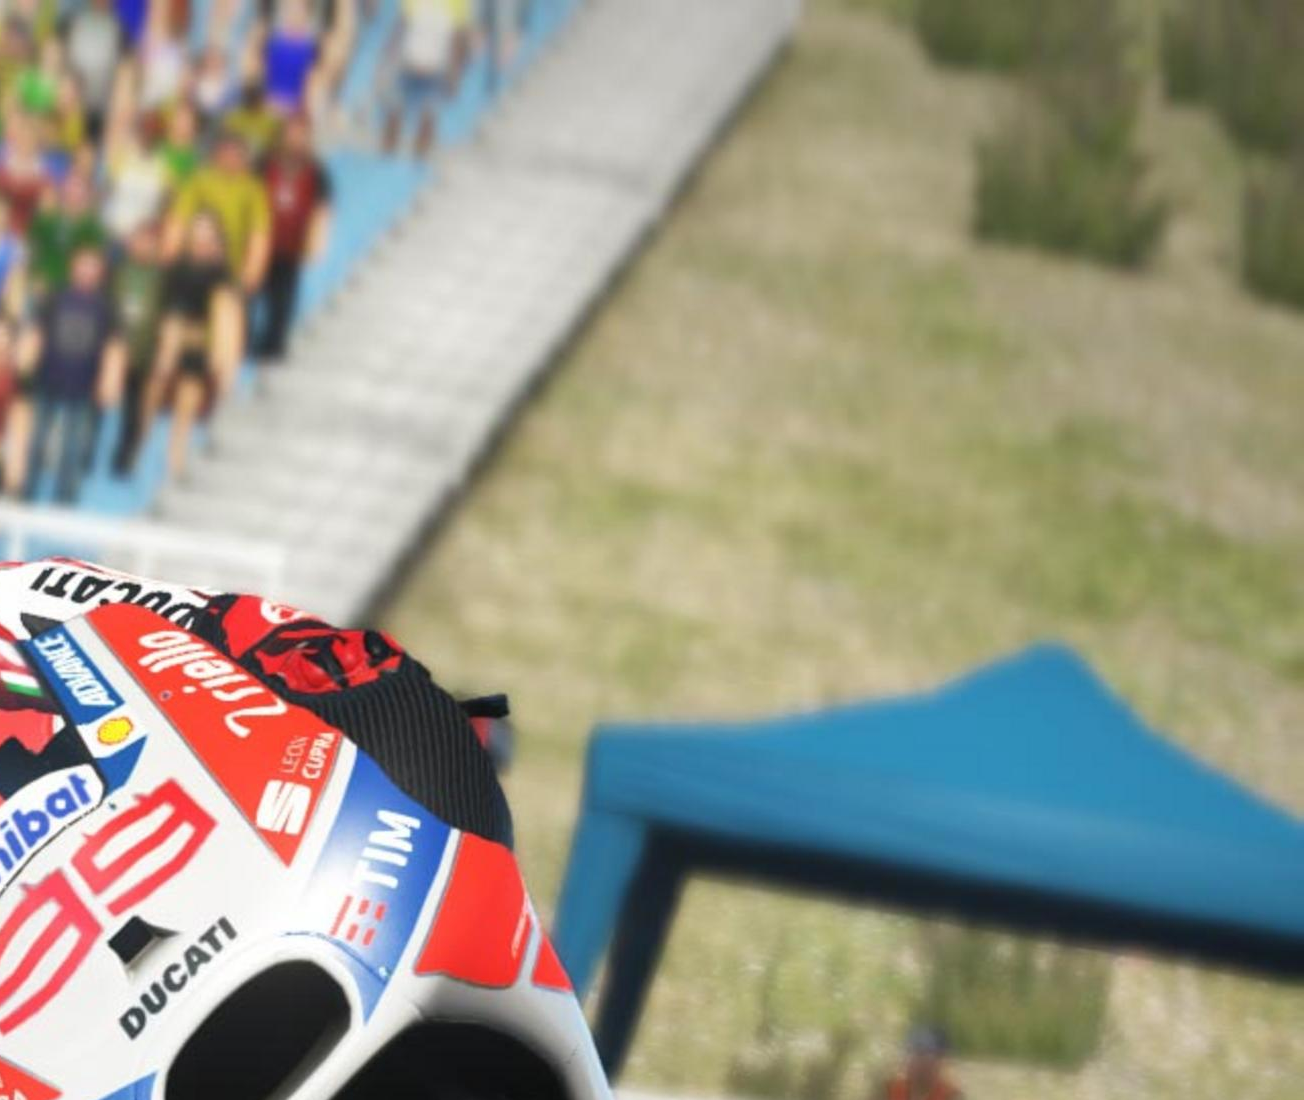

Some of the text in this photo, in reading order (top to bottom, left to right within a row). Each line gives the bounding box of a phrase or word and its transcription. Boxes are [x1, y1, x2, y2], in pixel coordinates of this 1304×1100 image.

[301, 732, 335, 779] CUPRA
[350, 809, 421, 889] TIM
[119, 916, 239, 1041] DUCATI
